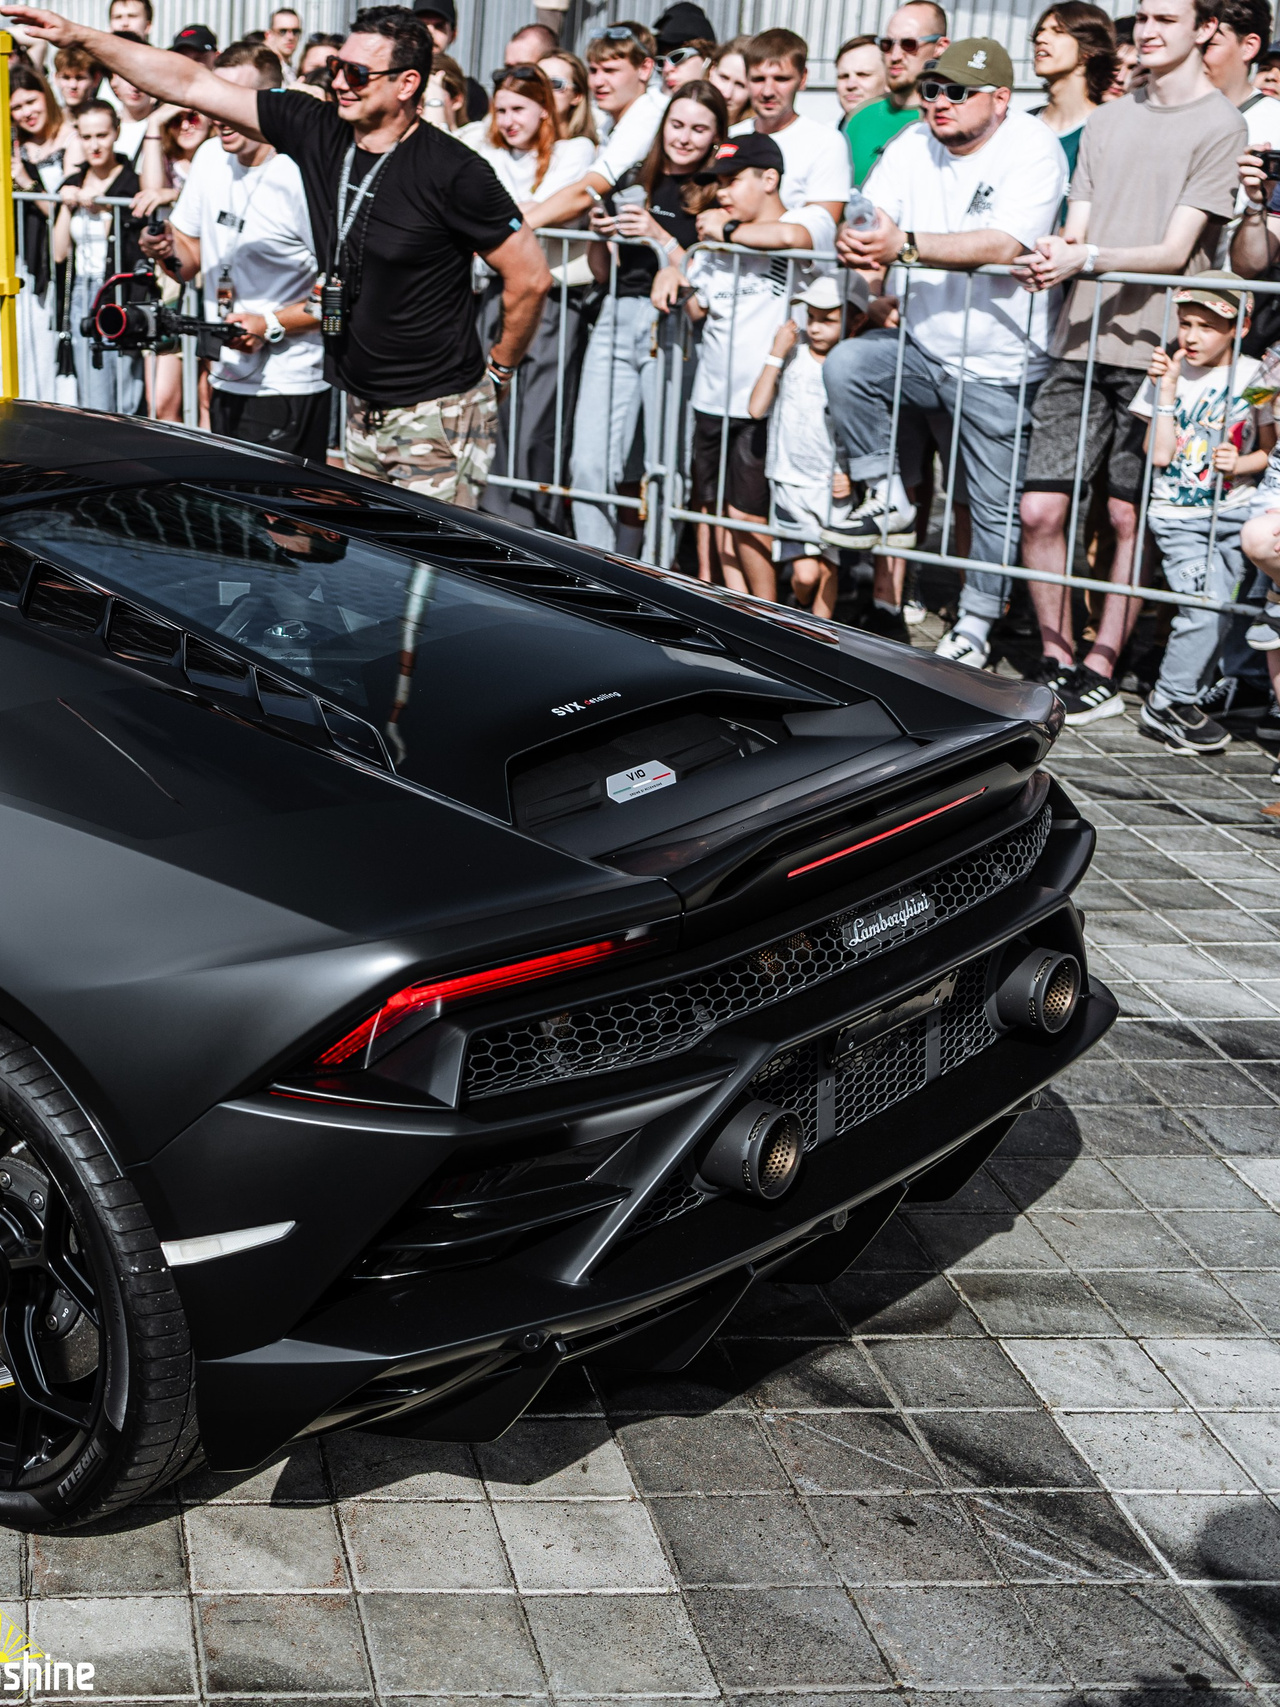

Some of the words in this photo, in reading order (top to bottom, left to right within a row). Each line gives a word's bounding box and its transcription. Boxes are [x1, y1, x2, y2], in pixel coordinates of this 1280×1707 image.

[551, 701, 586, 716] SVX
[625, 769, 646, 781] V10
[848, 892, 931, 947] Lamborghini
